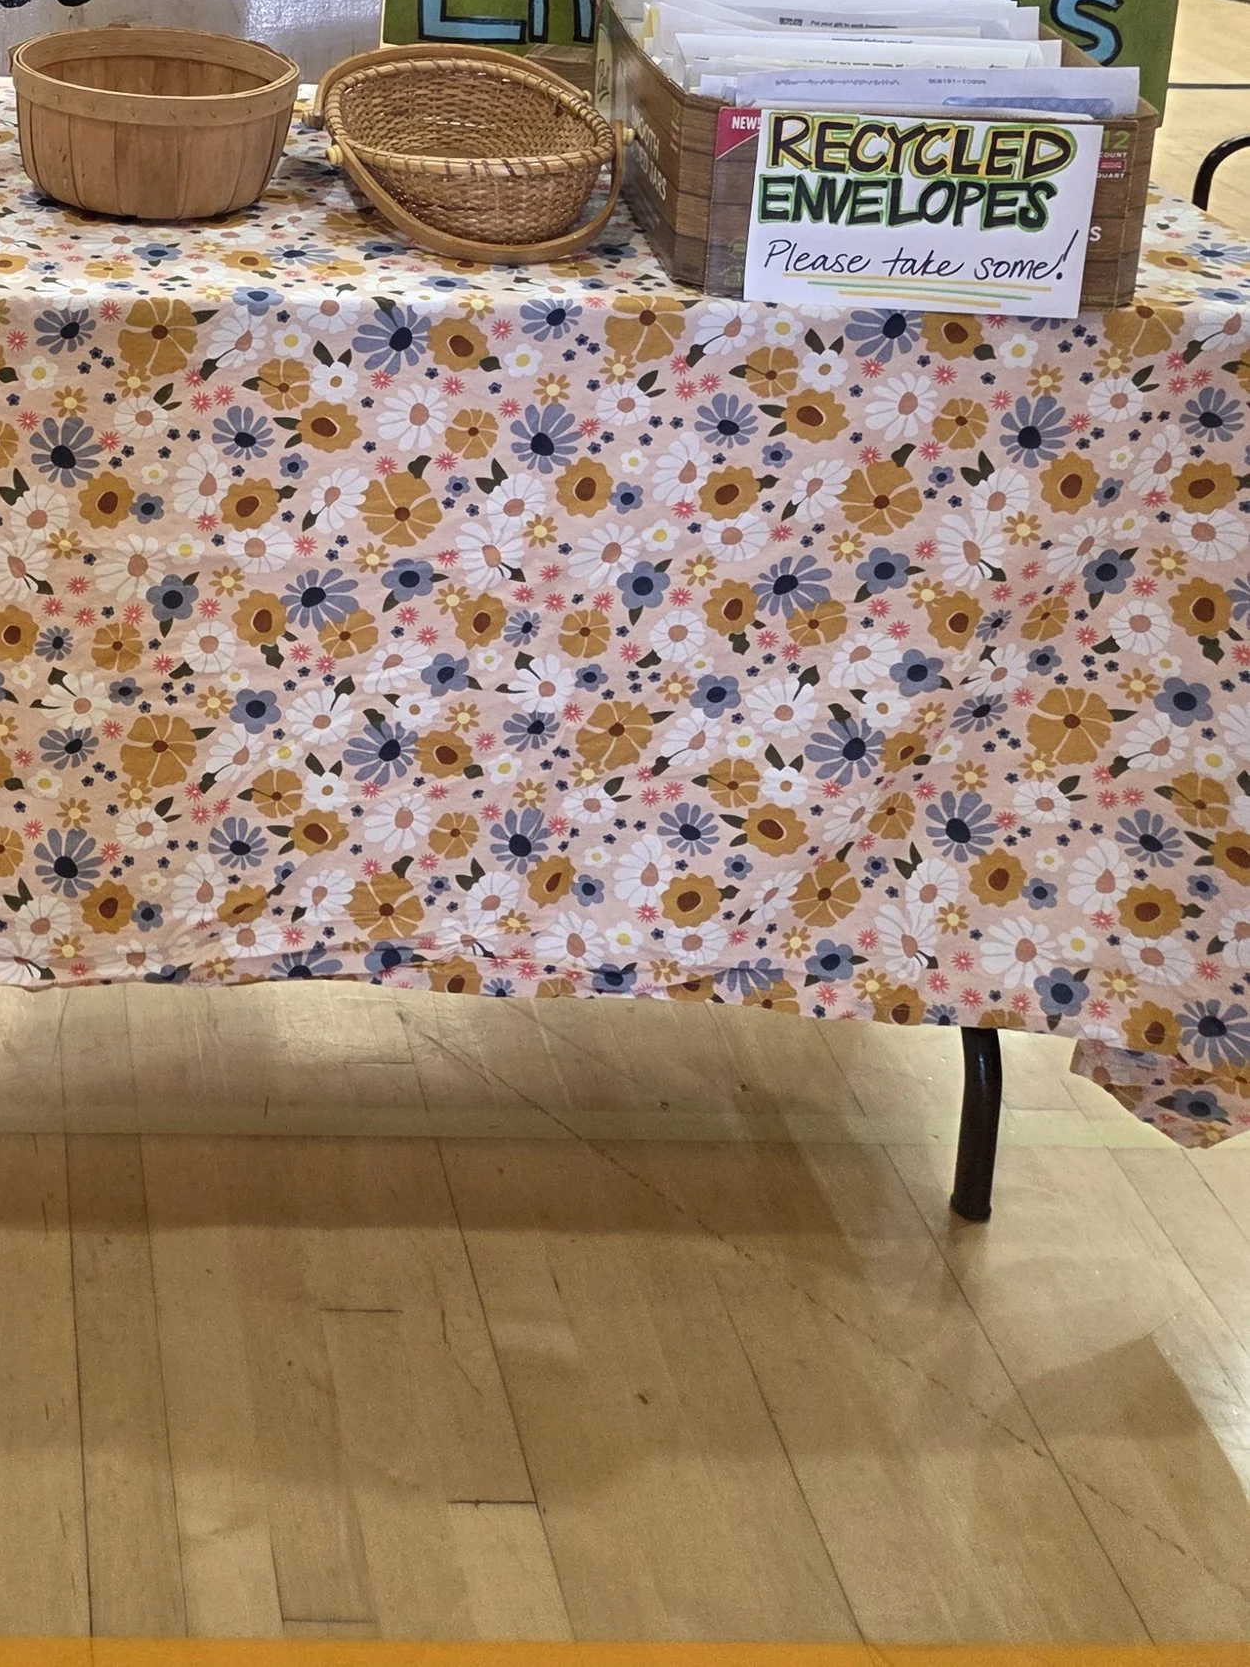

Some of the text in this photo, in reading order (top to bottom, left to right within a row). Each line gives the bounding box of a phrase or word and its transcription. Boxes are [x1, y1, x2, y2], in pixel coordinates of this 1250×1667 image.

[768, 113, 1076, 180] RECYCLED
[1103, 130, 1130, 151] 12
[758, 174, 1058, 232] ENVELOPES
[764, 229, 1079, 281] Please take some!
